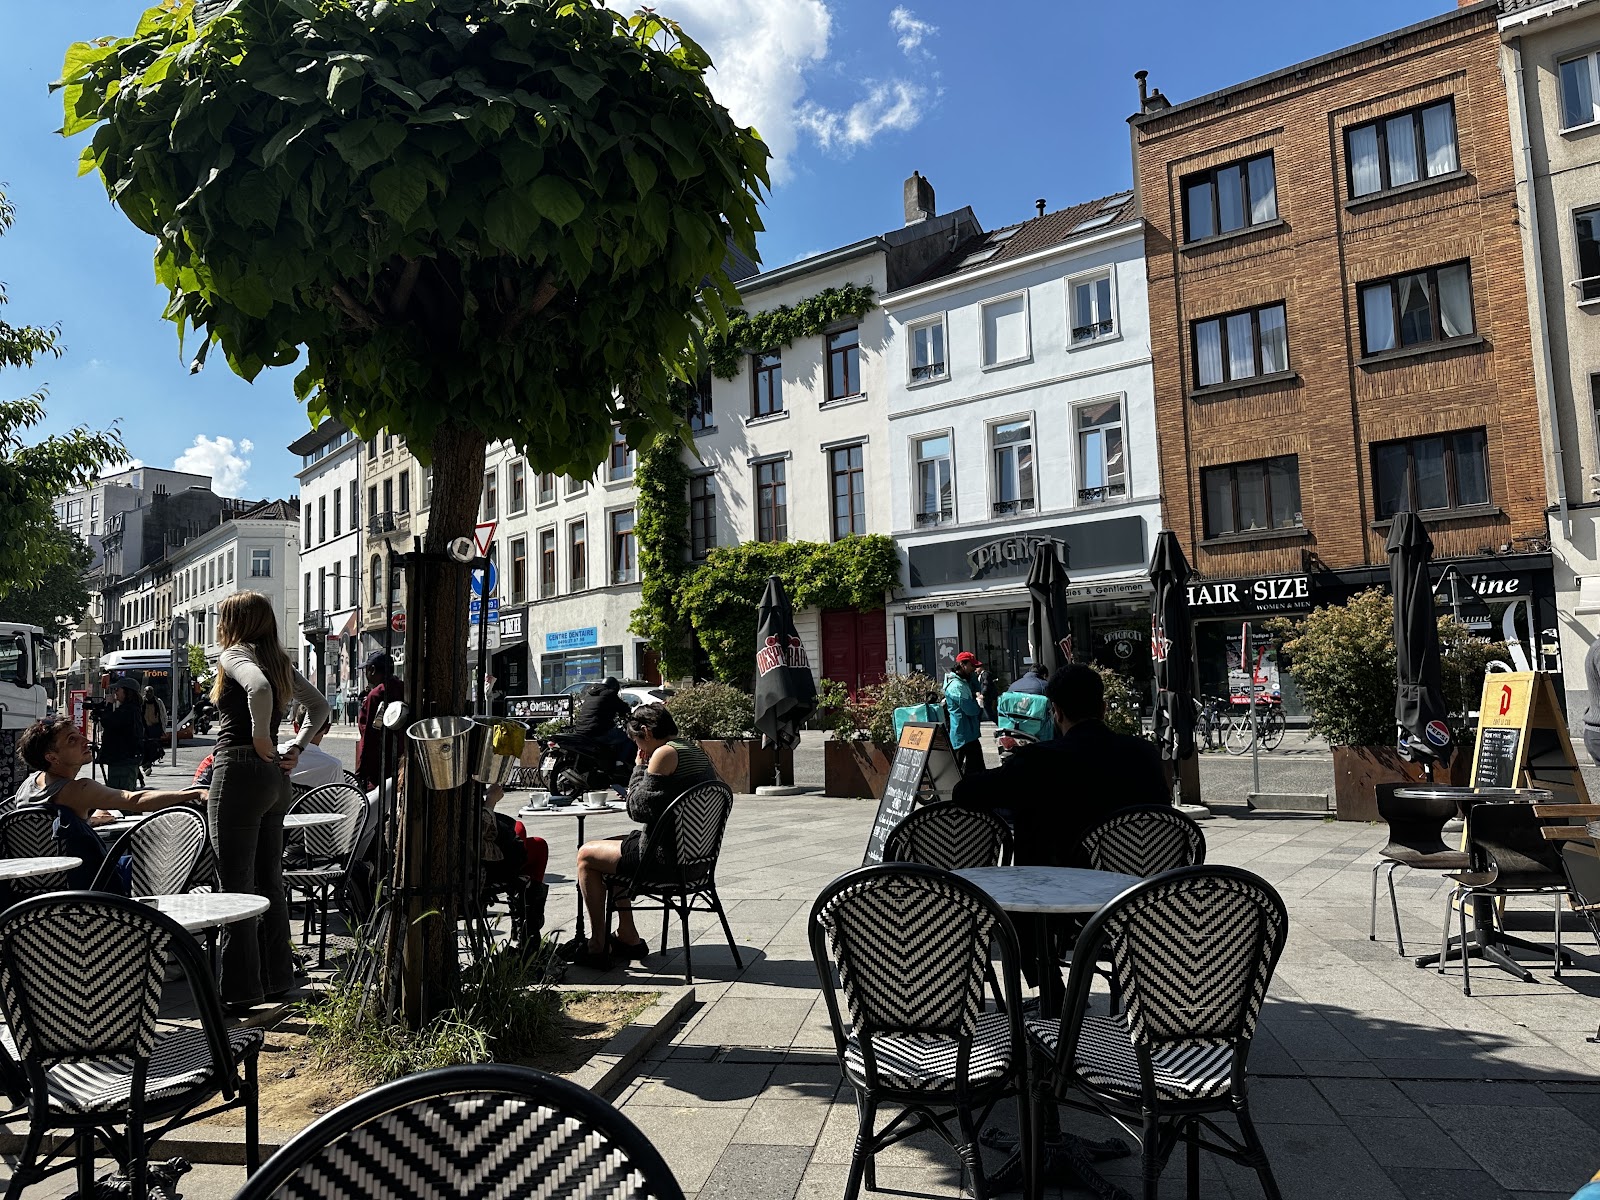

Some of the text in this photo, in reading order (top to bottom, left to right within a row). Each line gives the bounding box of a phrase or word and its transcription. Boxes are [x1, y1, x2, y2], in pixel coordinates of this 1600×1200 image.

[967, 534, 1067, 580] SPAGNOI
[1095, 584, 1143, 594] Gentlemen
[1186, 577, 1309, 606] HAIR SIZE
[905, 600, 968, 611] Hairdresser Barber
[1256, 603, 1285, 611] WOMEN
[548, 629, 594, 641] CENTRE DENTAIRE
[143, 669, 168, 678] Trône
[1427, 724, 1449, 743] PEPSI
